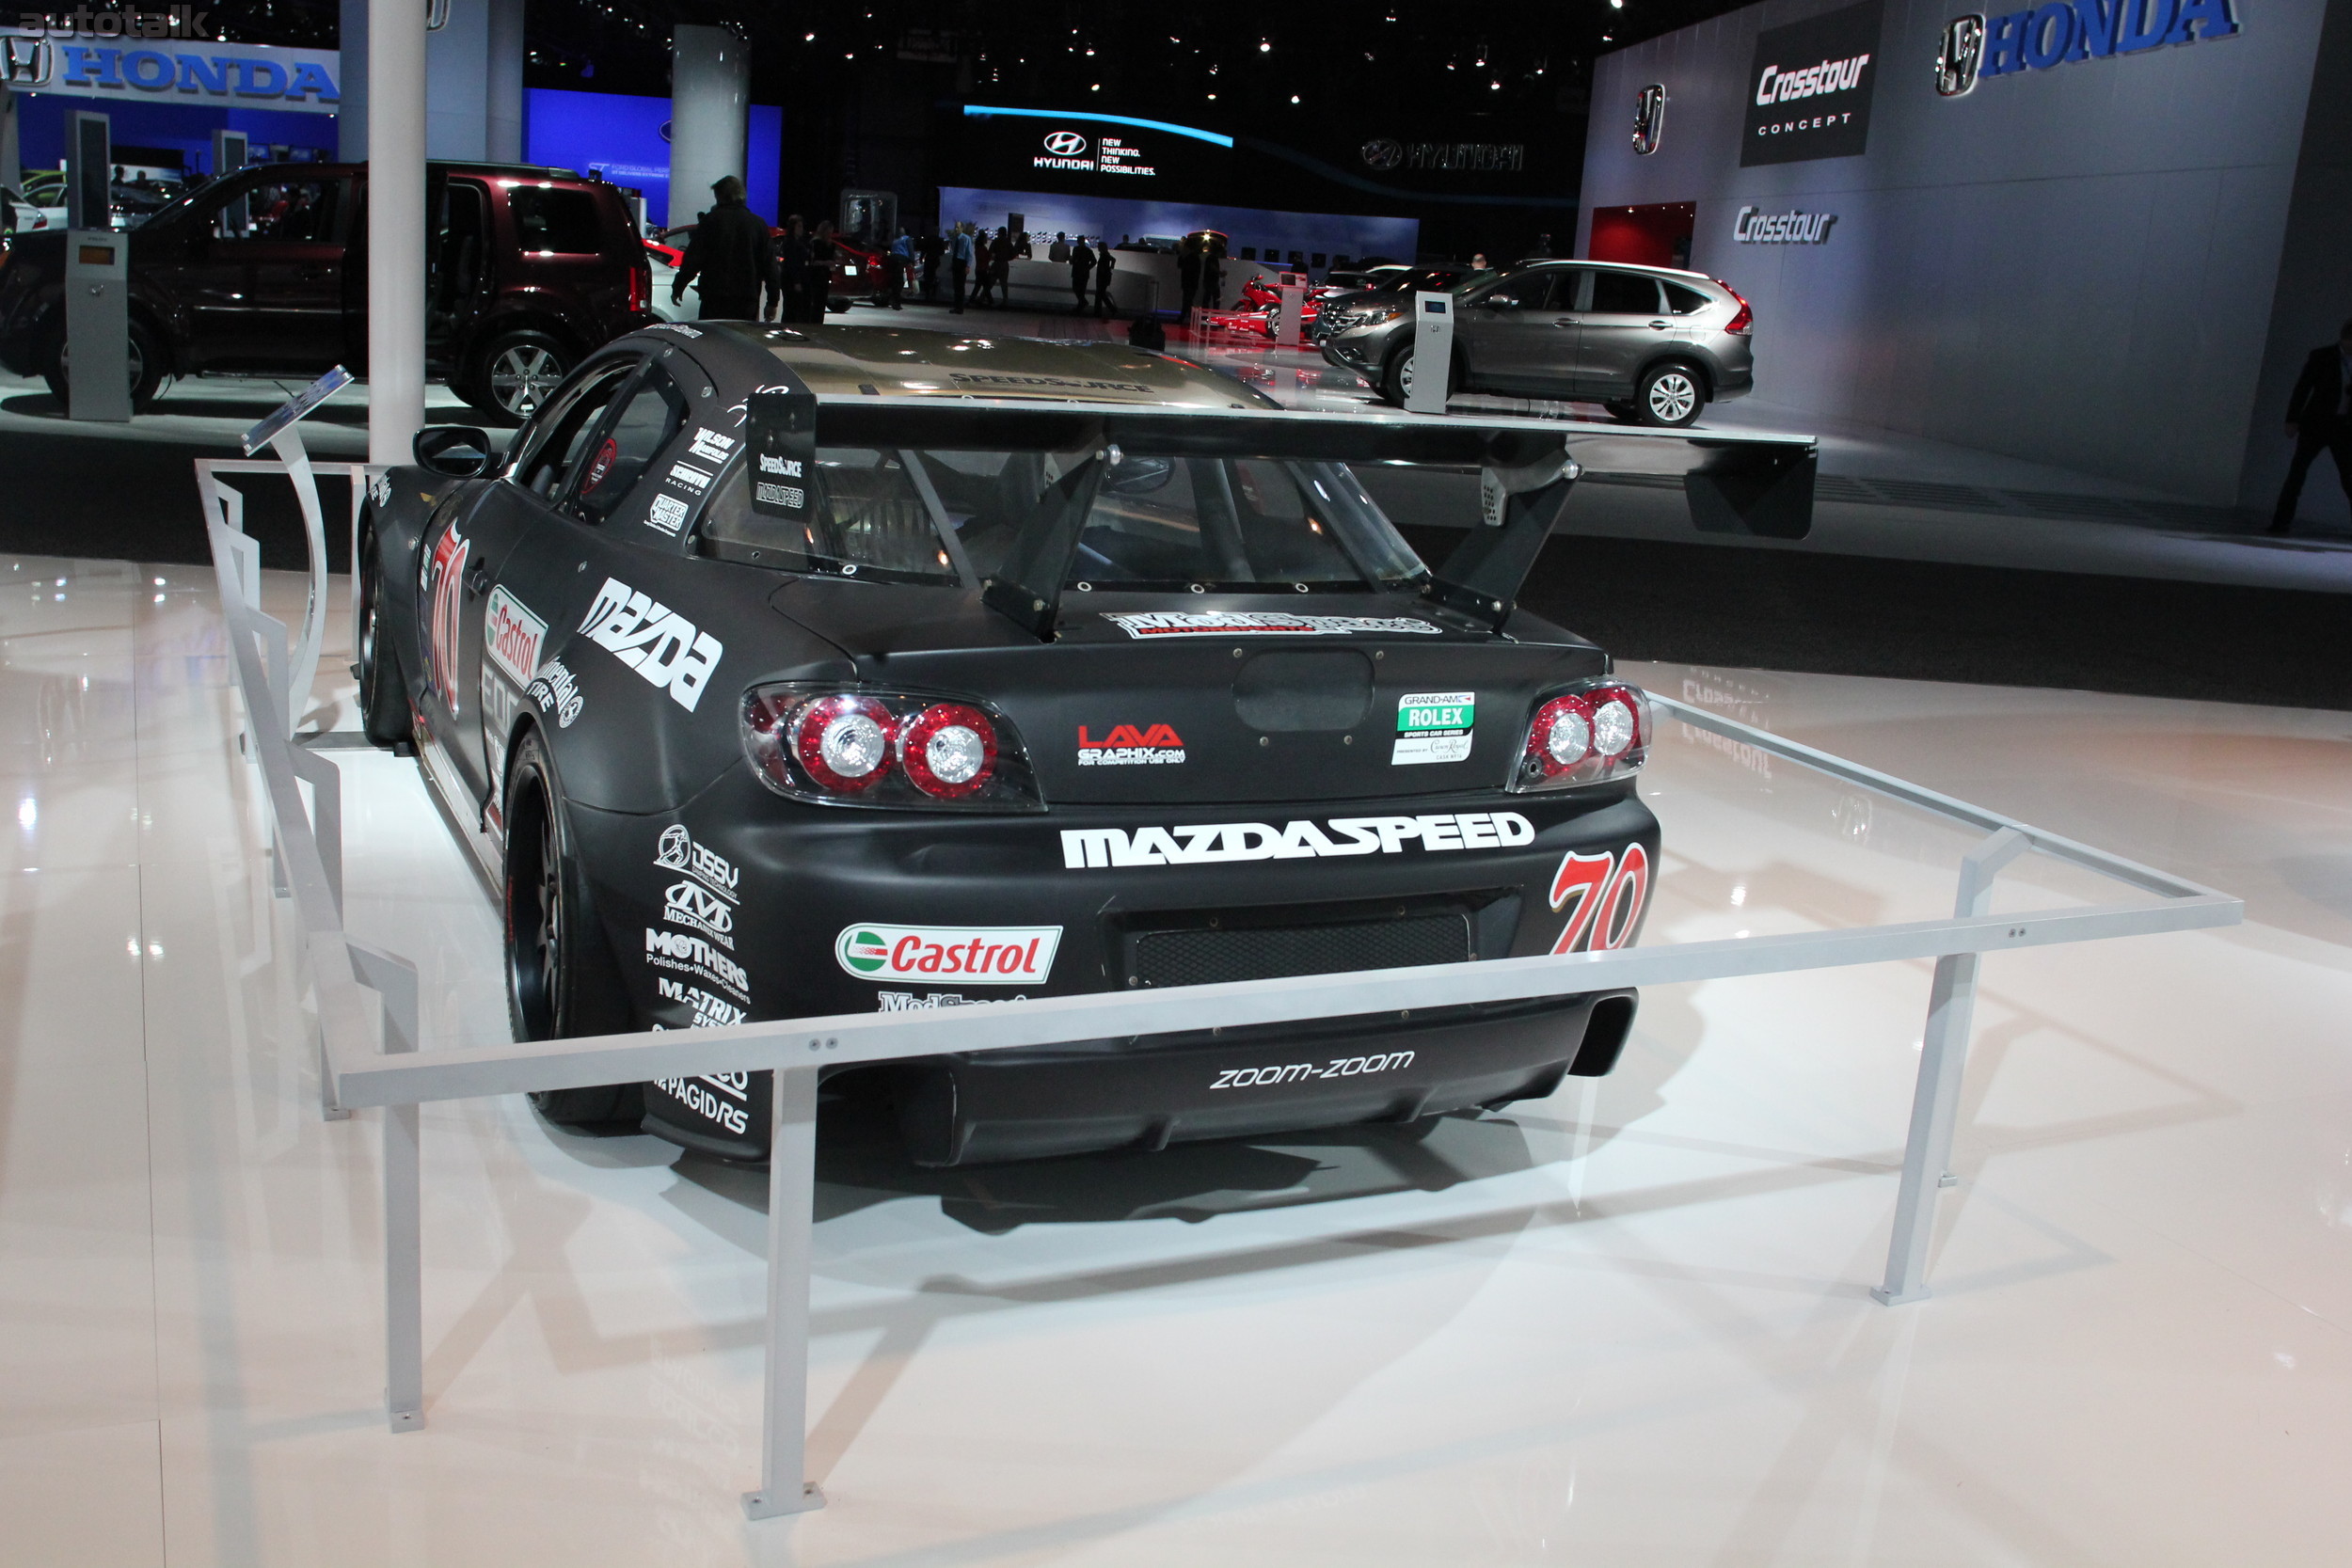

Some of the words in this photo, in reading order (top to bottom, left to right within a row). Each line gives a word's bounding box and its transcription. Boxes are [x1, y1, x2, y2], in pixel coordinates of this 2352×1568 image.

[1978, 0, 2239, 79] HONDA
[62, 46, 340, 100] HONDA
[1756, 54, 1870, 105] Crosstour
[1758, 113, 1851, 135] CONCEPT
[1102, 137, 1121, 147] NEW
[1033, 156, 1094, 171] HYUNDAI
[1101, 155, 1120, 165] NEW
[1733, 205, 1832, 243] Crosstour
[693, 427, 736, 451] WILSON
[665, 477, 702, 497] RACING
[653, 497, 686, 517] QUARTER
[653, 508, 683, 528] MASTER
[432, 516, 470, 721] 70
[495, 604, 539, 680] Castrol
[526, 681, 555, 713] TIRE
[1408, 708, 1463, 727] ROLEX
[1078, 723, 1184, 749] LAVA
[1059, 811, 1536, 869] MAZDASPEED
[1549, 842, 1648, 955] 70
[714, 932, 735, 951] WEAR
[891, 935, 1041, 974] Castrol
[646, 927, 749, 991] MOTHERS
[659, 976, 747, 1026] MATRIX
